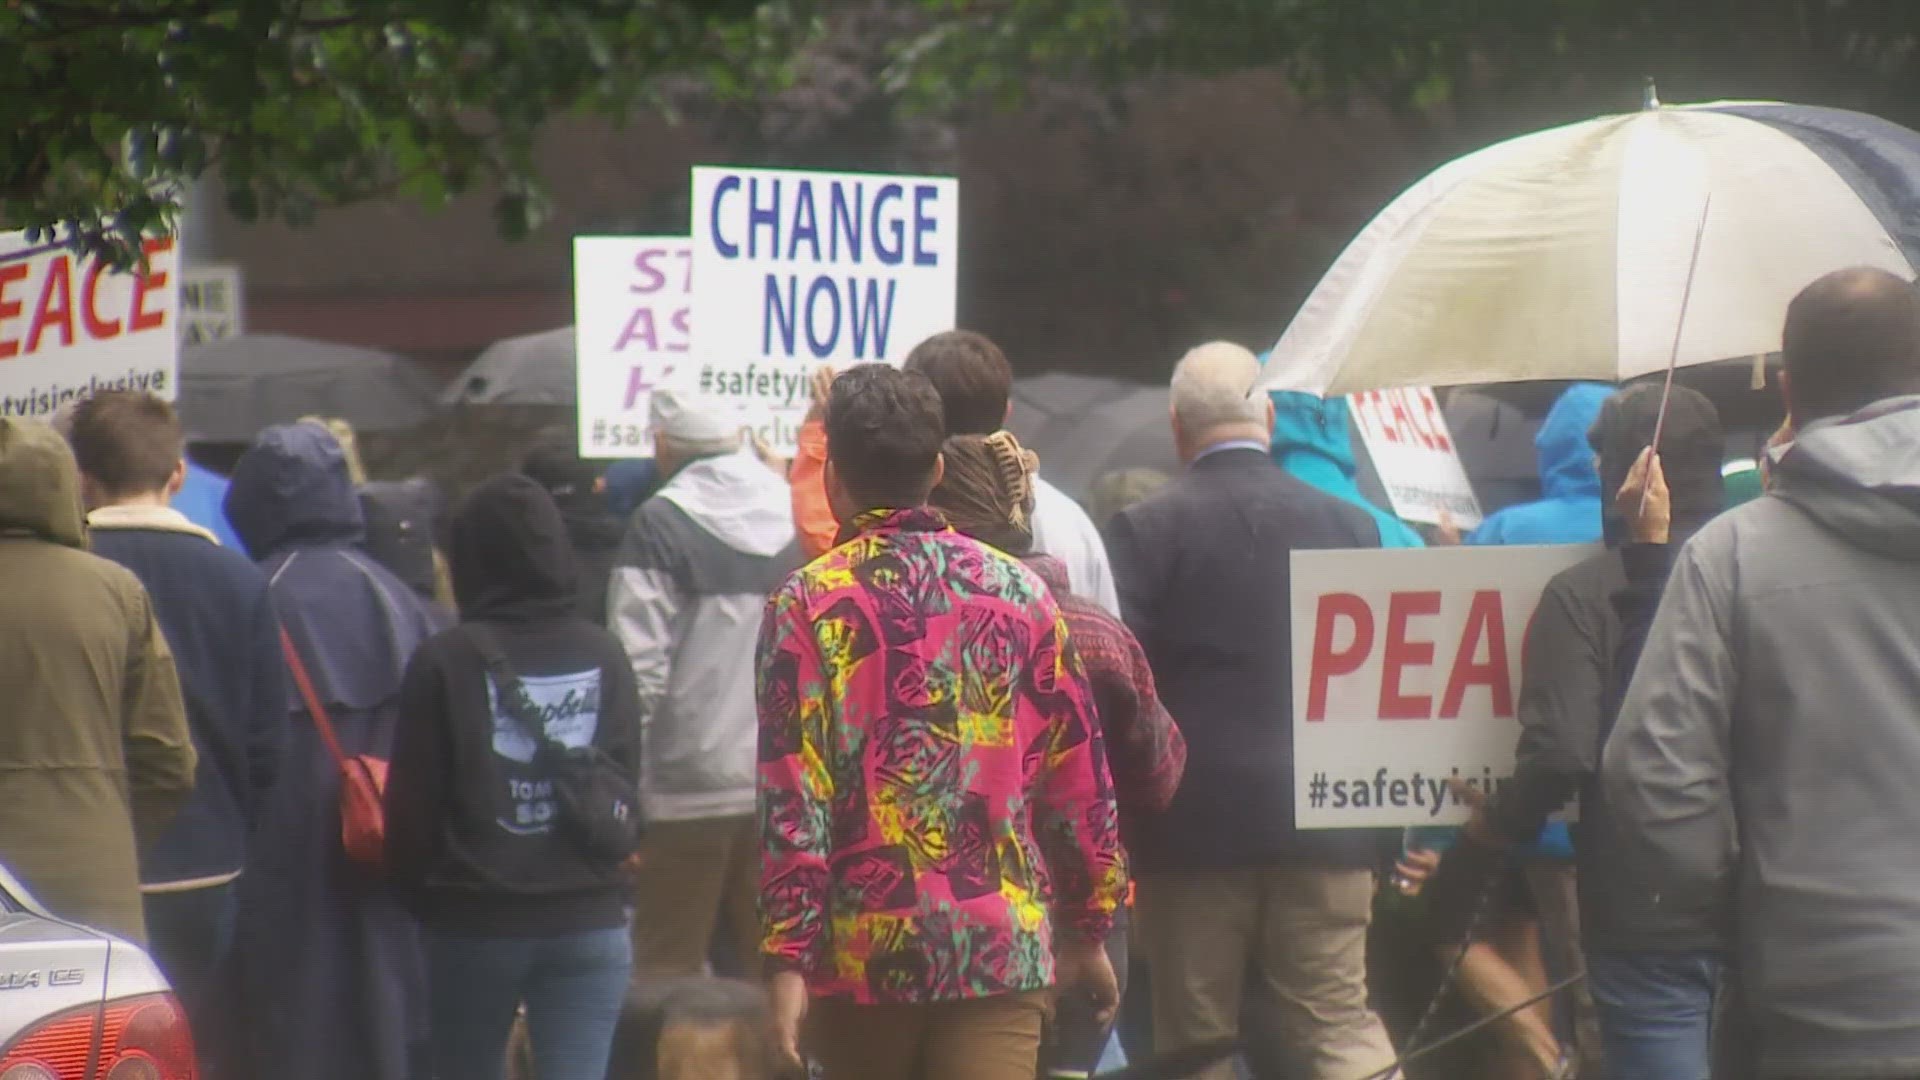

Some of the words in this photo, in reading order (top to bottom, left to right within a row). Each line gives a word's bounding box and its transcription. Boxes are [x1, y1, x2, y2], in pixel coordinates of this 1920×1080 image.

[710, 174, 940, 267] CHANGE
[762, 274, 897, 361] NOW
[699, 363, 814, 406] #safetyi
[1305, 589, 1541, 722] PEA
